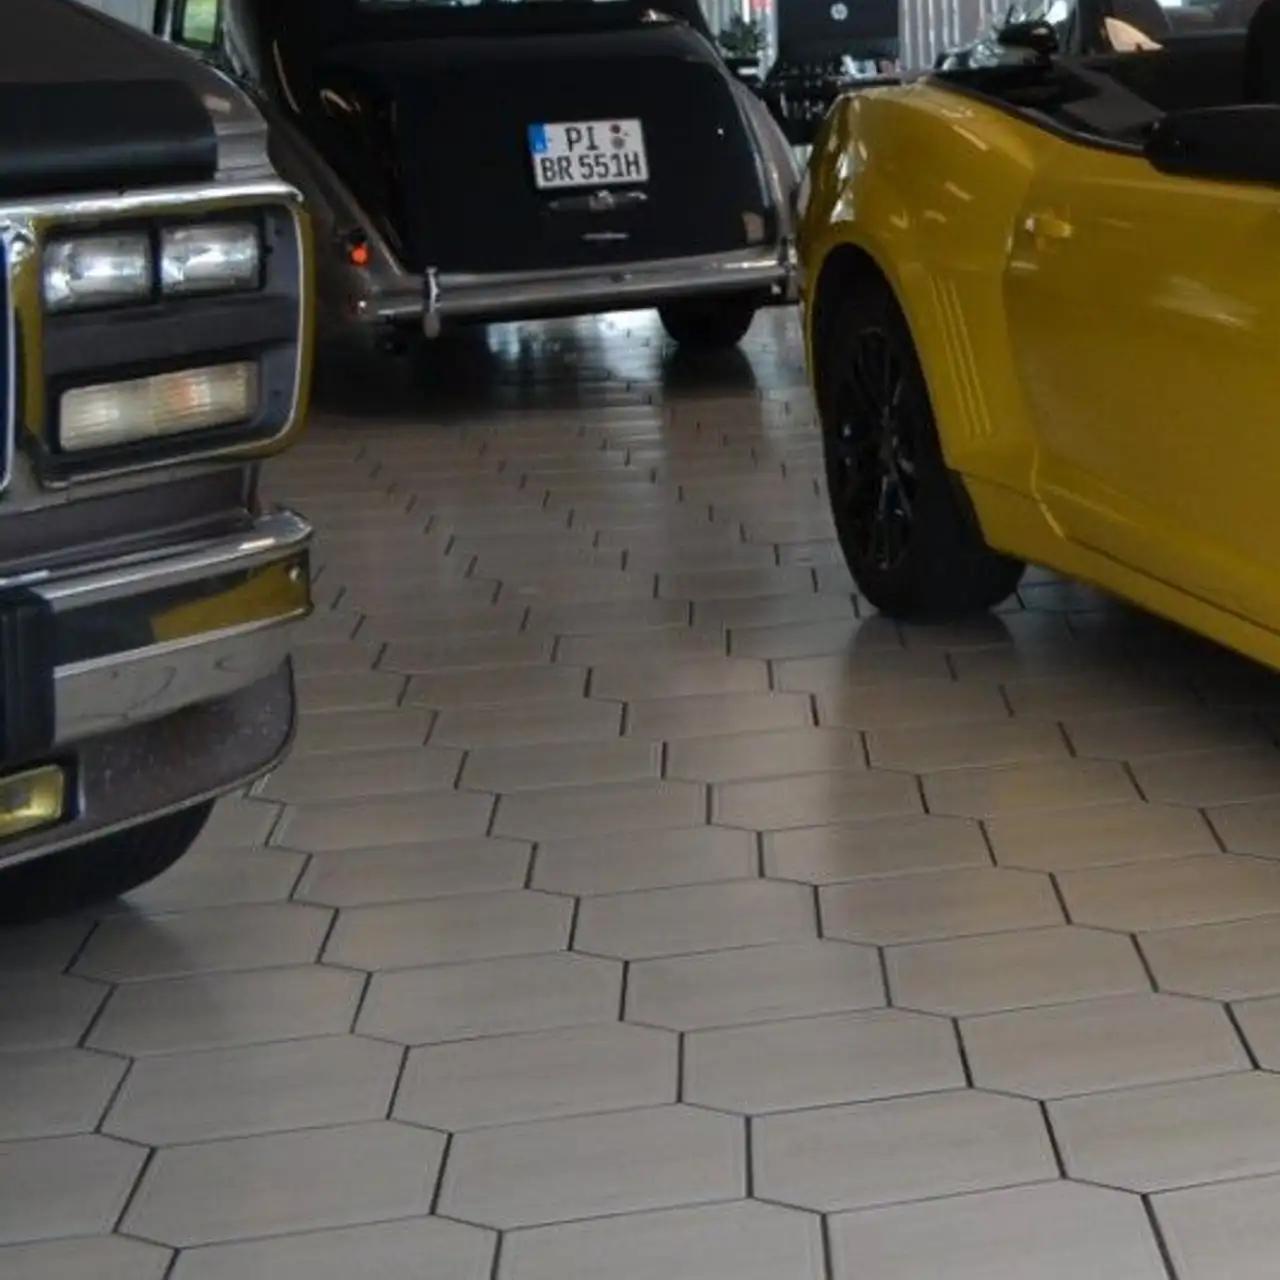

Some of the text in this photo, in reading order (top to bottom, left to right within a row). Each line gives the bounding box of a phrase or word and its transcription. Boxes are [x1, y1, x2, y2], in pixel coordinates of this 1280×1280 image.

[564, 125, 600, 153] PI
[540, 151, 641, 182] BR 551H
